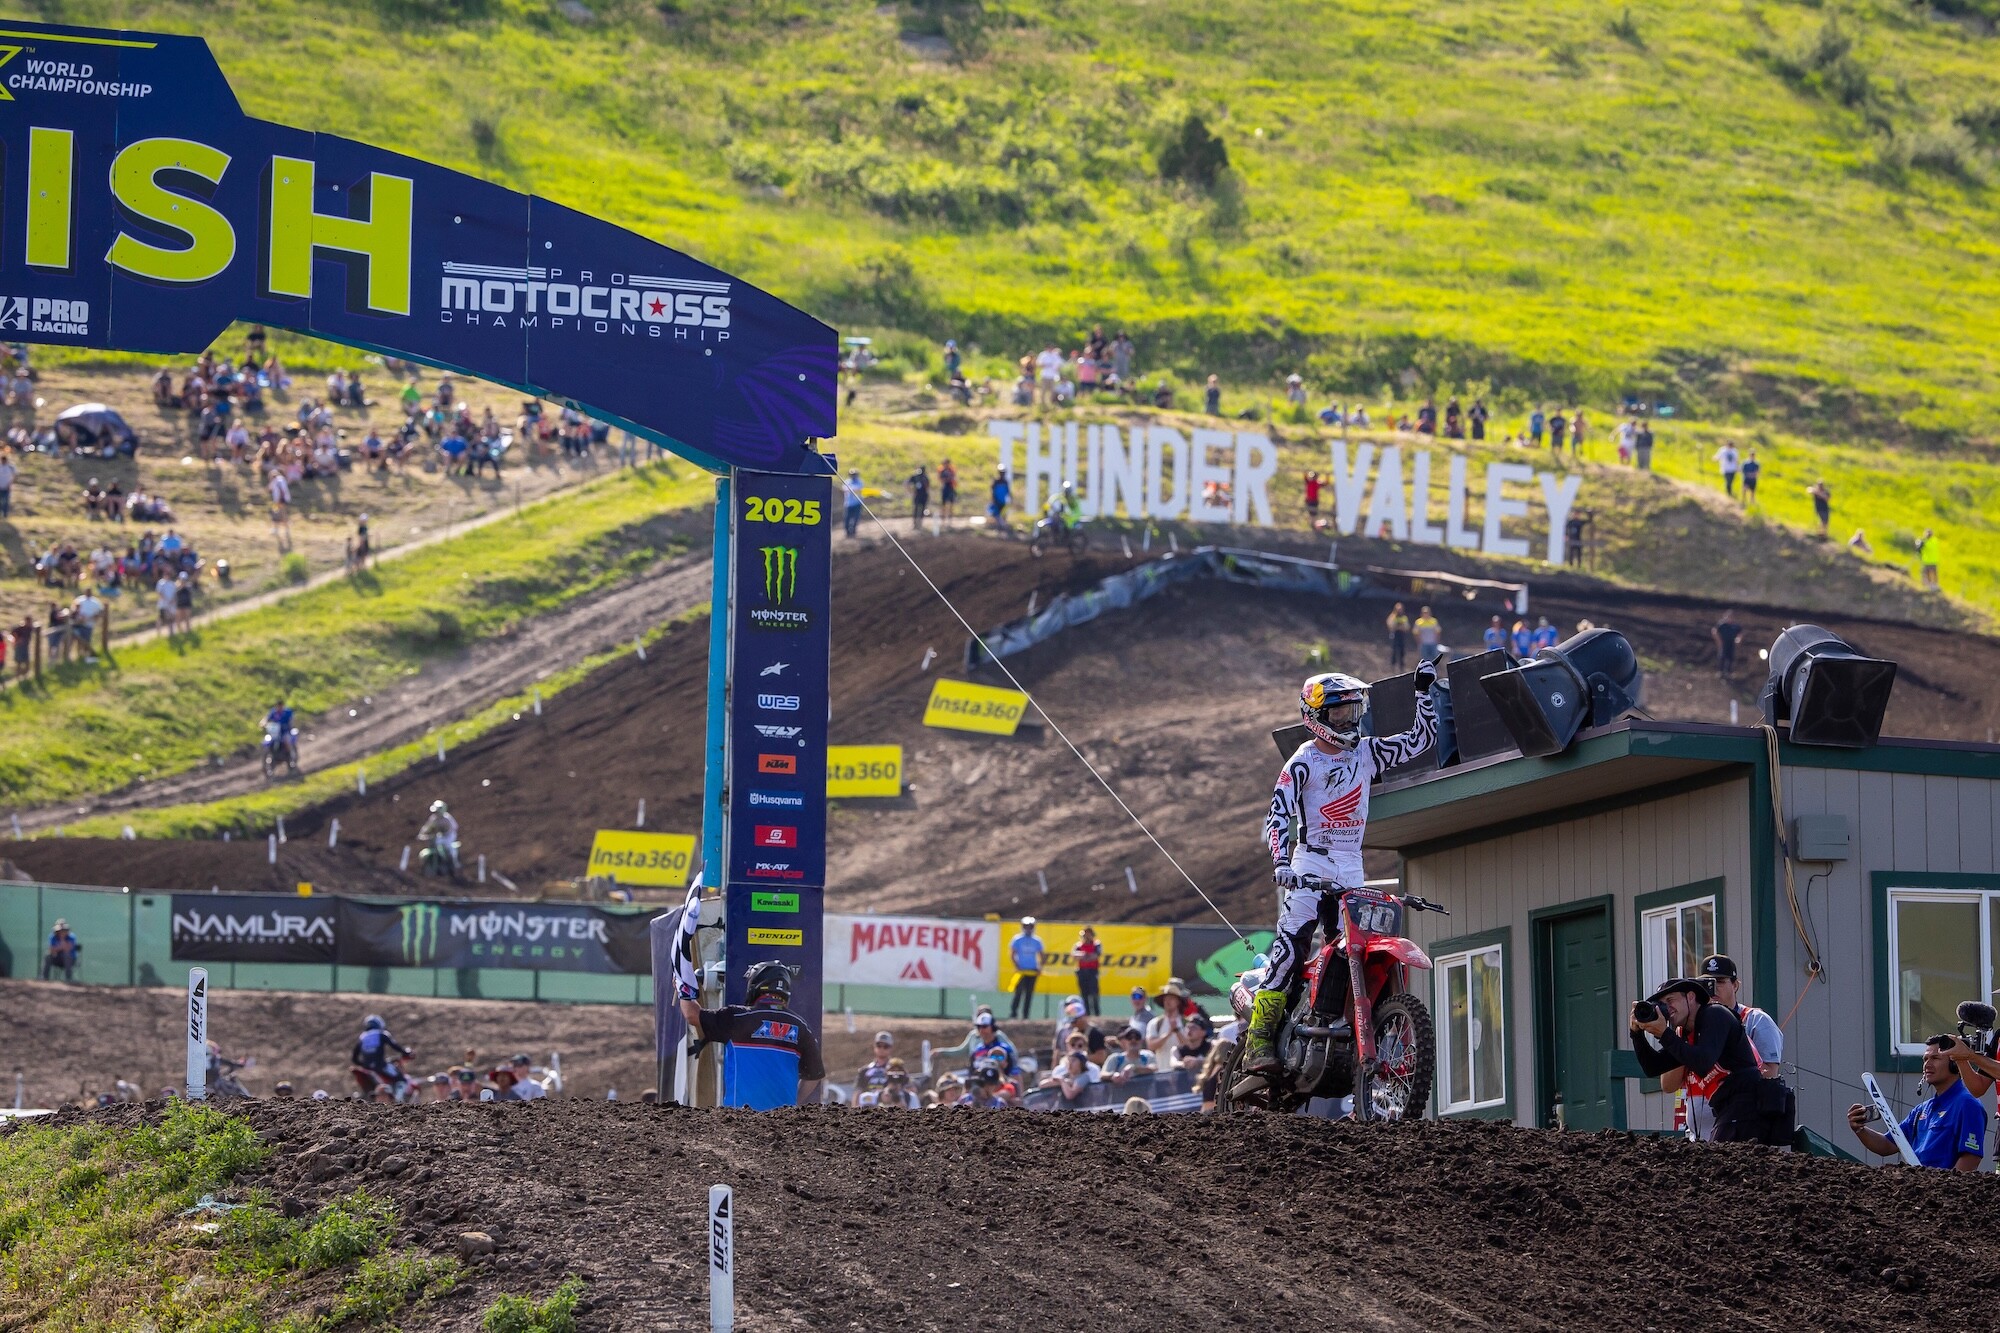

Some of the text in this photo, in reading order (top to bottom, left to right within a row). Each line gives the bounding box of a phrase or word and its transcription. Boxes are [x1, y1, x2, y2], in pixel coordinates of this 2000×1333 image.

[26, 59, 93, 78] WORLD
[8, 74, 153, 98] CHAMPIONSHIP
[550, 268, 625, 285] PRO
[32, 297, 89, 323] PRO
[441, 276, 731, 329] MOTOCROSS
[31, 320, 89, 336] RACING
[440, 310, 731, 343] CHAMPIONSHIP
[987, 420, 1582, 565] THUNDER VALLEY
[745, 496, 821, 526] 2025
[751, 609, 808, 623] MONSTER
[758, 694, 800, 710] WPS
[931, 694, 1020, 720] Insta360
[756, 724, 802, 736] FLY
[765, 759, 789, 769] KTM
[759, 794, 803, 806] Husqvarna
[1320, 819, 1364, 829] HONDA
[594, 848, 687, 871] Insta360
[757, 898, 794, 907] Kawasaki
[172, 908, 335, 938] NAMURA
[450, 910, 609, 944] MONSTER
[1358, 904, 1395, 933] 10
[758, 932, 800, 940] DUNLOP
[850, 922, 983, 971] MAVERIK
[471, 943, 585, 959] ENERGY
[1041, 953, 1158, 968] DULOP
[190, 997, 200, 1042] UFO
[751, 1019, 799, 1045] AMA
[713, 1219, 724, 1271] UFO
